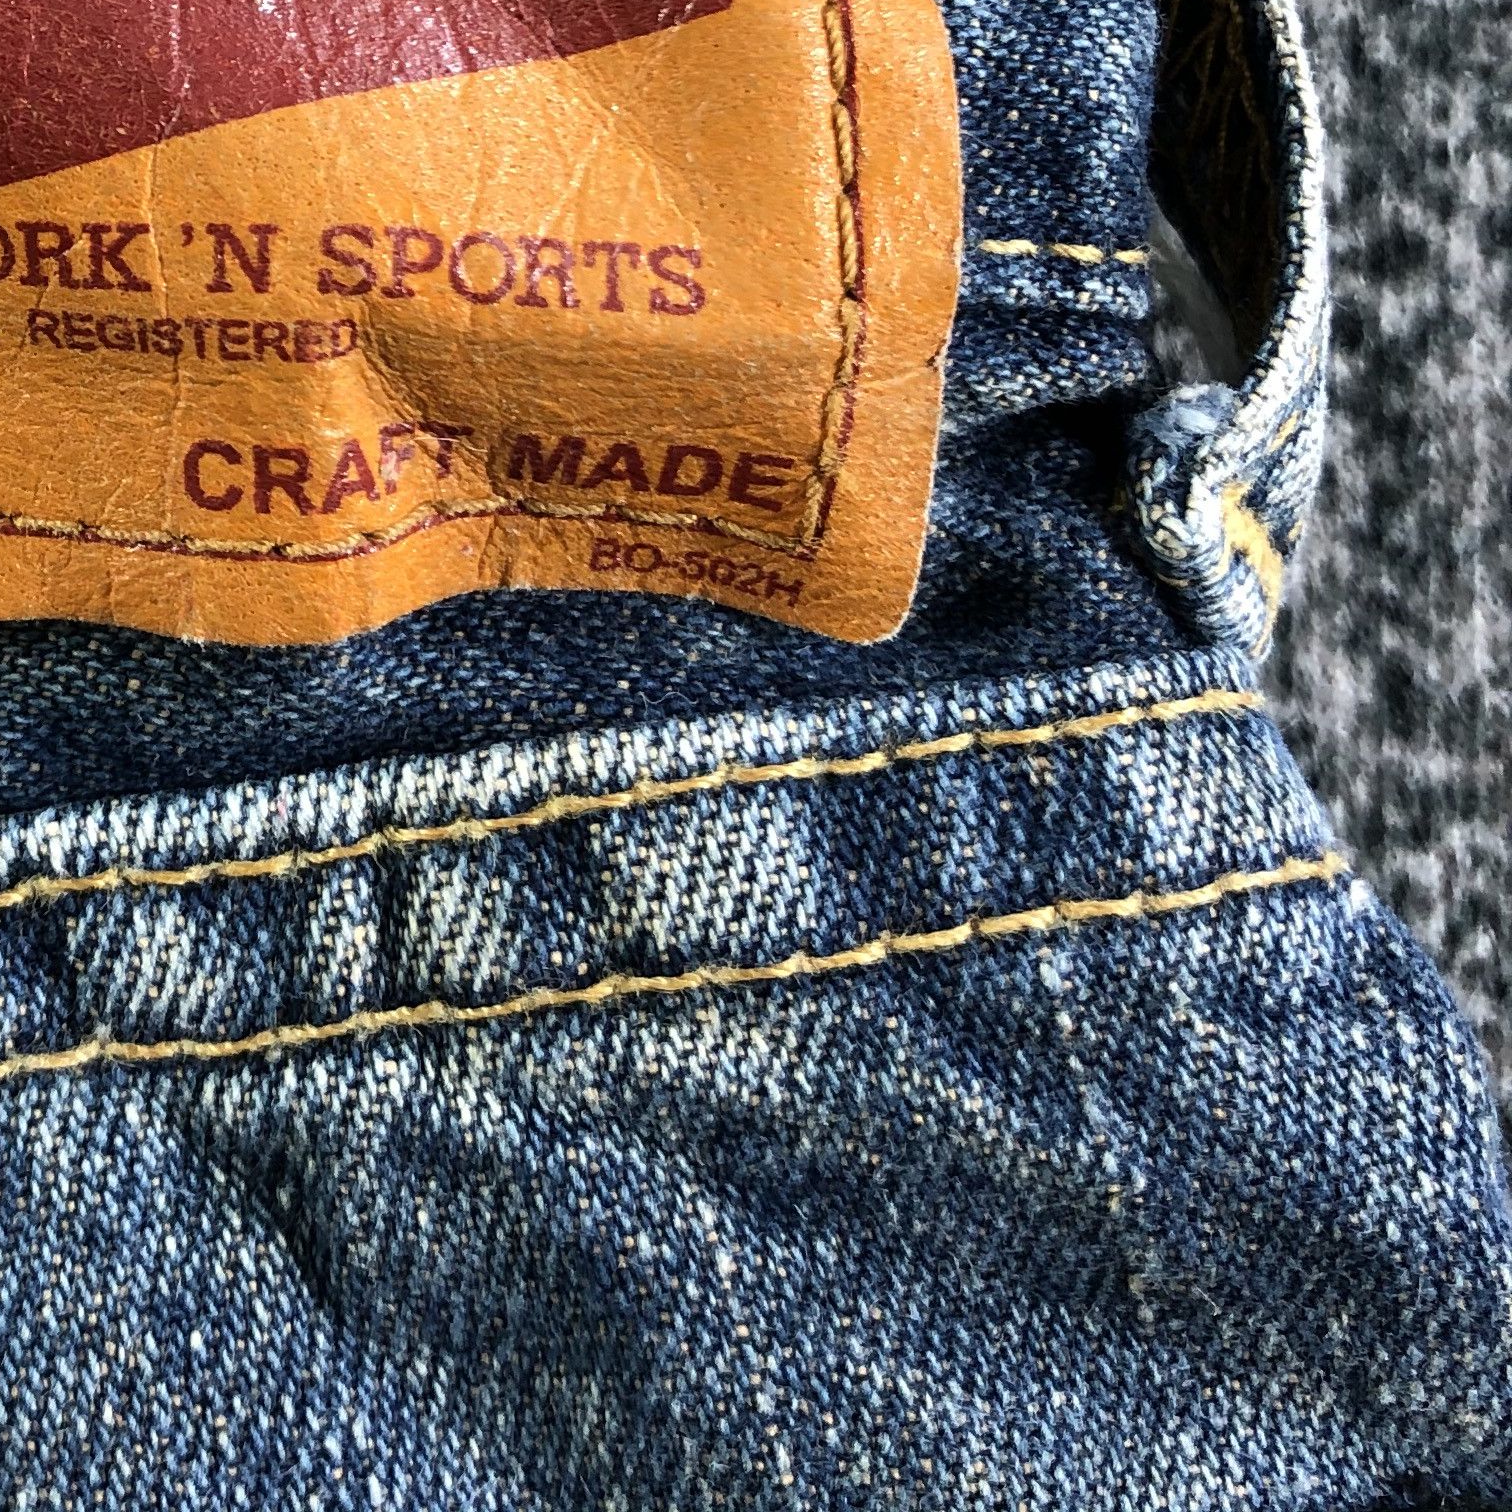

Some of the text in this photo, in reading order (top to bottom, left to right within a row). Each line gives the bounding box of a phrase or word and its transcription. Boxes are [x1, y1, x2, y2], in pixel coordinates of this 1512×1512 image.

[181, 222, 280, 293] 'N
[316, 224, 707, 316] SPORTS
[28, 310, 359, 364] REGISTERED
[183, 422, 795, 514] CRAFT MADE
